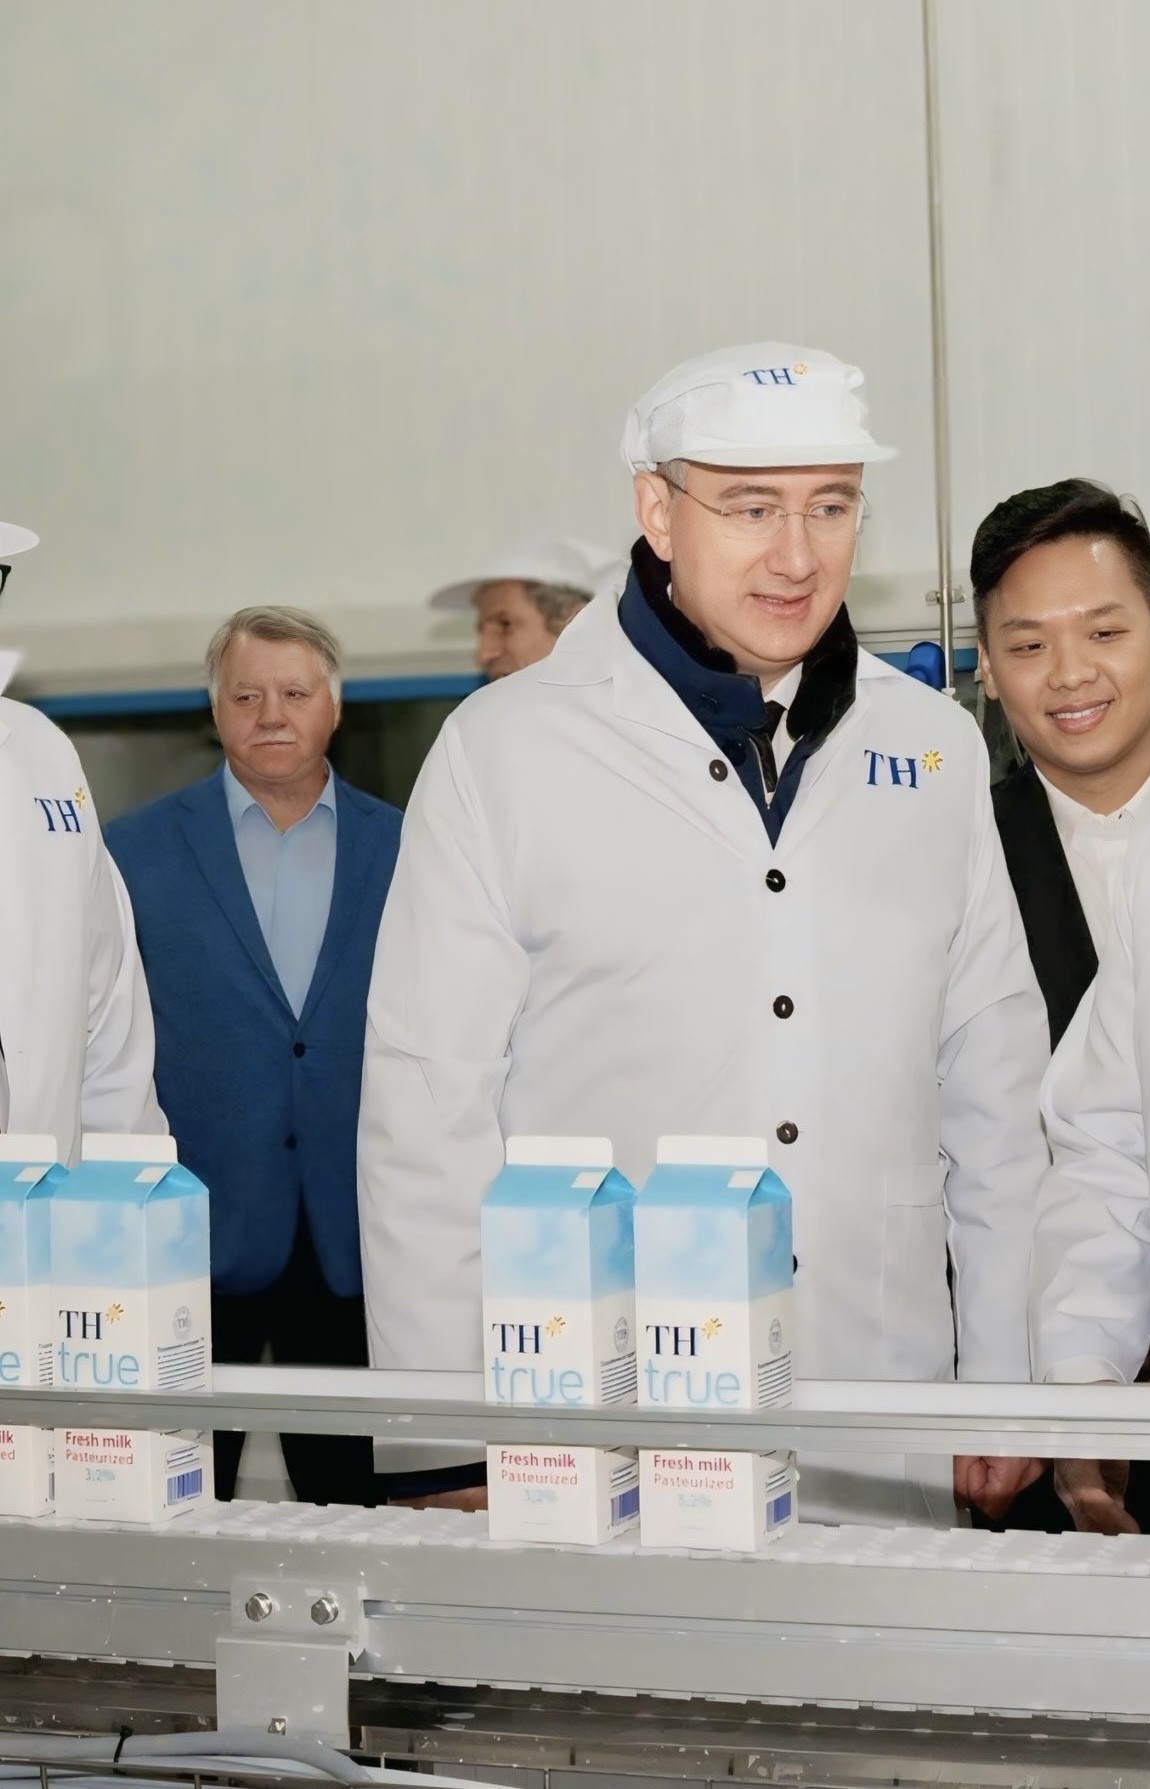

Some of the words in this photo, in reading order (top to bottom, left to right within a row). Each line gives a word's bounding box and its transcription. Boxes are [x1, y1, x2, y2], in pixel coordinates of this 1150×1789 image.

[743, 367, 797, 385] TH
[864, 749, 919, 789] TH
[34, 797, 81, 833] TH
[59, 1310, 103, 1340] TH
[492, 1323, 542, 1354] TH
[646, 1325, 697, 1356] TH
[58, 1342, 140, 1385] true
[491, 1357, 583, 1403] true
[644, 1360, 740, 1404] true
[66, 1431, 99, 1447] Fresh
[103, 1435, 132, 1449] milk
[66, 1449, 134, 1465] Pasteurized
[501, 1451, 539, 1466] Fresh
[544, 1454, 576, 1468] milk
[654, 1454, 693, 1470] Fresh
[699, 1457, 732, 1472] milk
[501, 1469, 577, 1485] Pasteurized
[654, 1473, 734, 1489] Pasteurized
